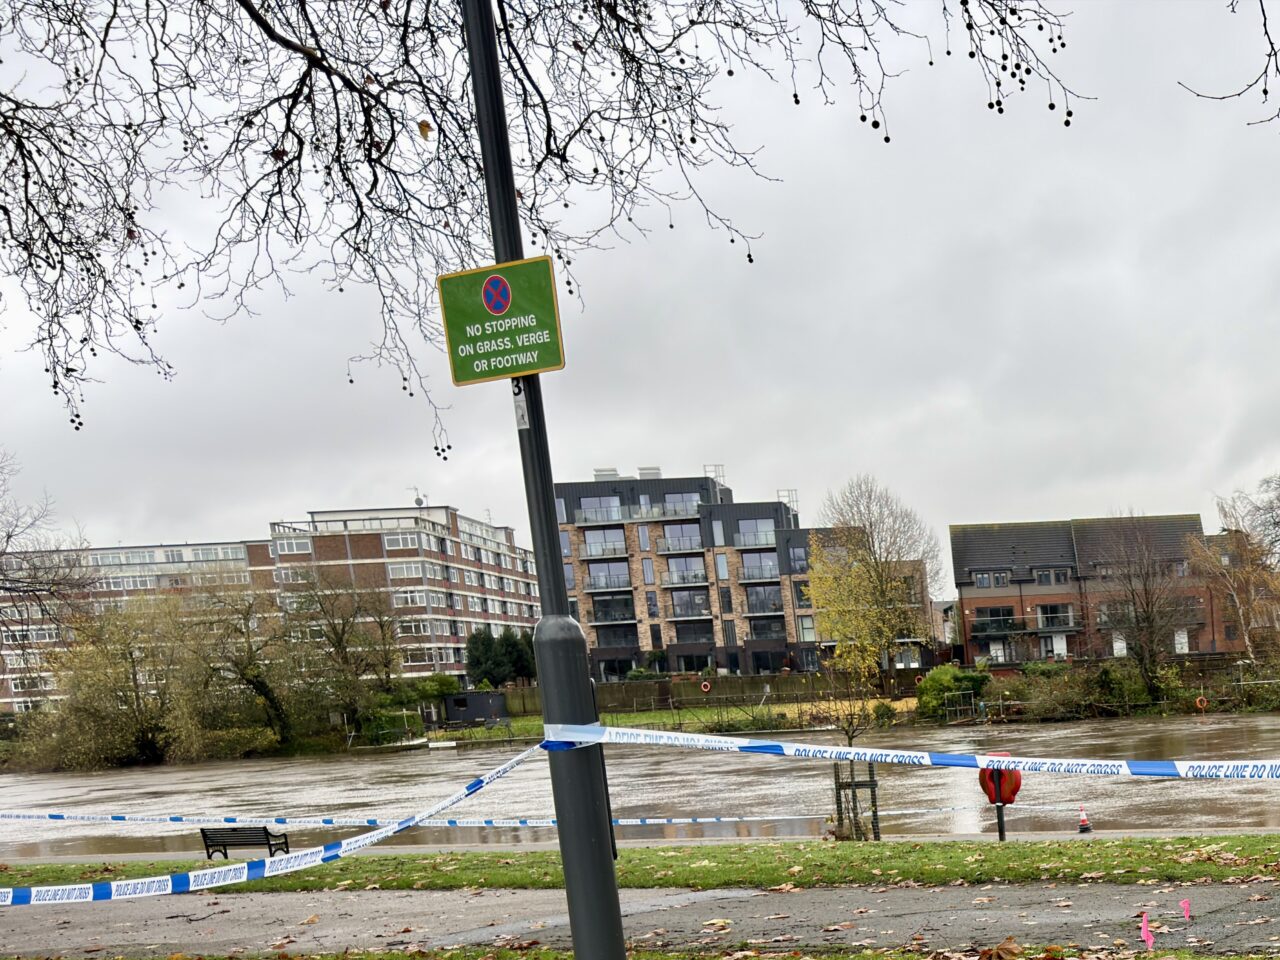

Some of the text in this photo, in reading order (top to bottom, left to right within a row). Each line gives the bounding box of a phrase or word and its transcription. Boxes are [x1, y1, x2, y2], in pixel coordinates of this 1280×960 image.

[466, 314, 536, 338] NO STOPPING
[458, 344, 474, 357] ON
[516, 330, 551, 347] VERGE
[473, 350, 539, 373] OR FOOTWAY
[1186, 764, 1224, 778] POLICE
[1224, 764, 1249, 778] LINE
[1249, 764, 1266, 779] DO
